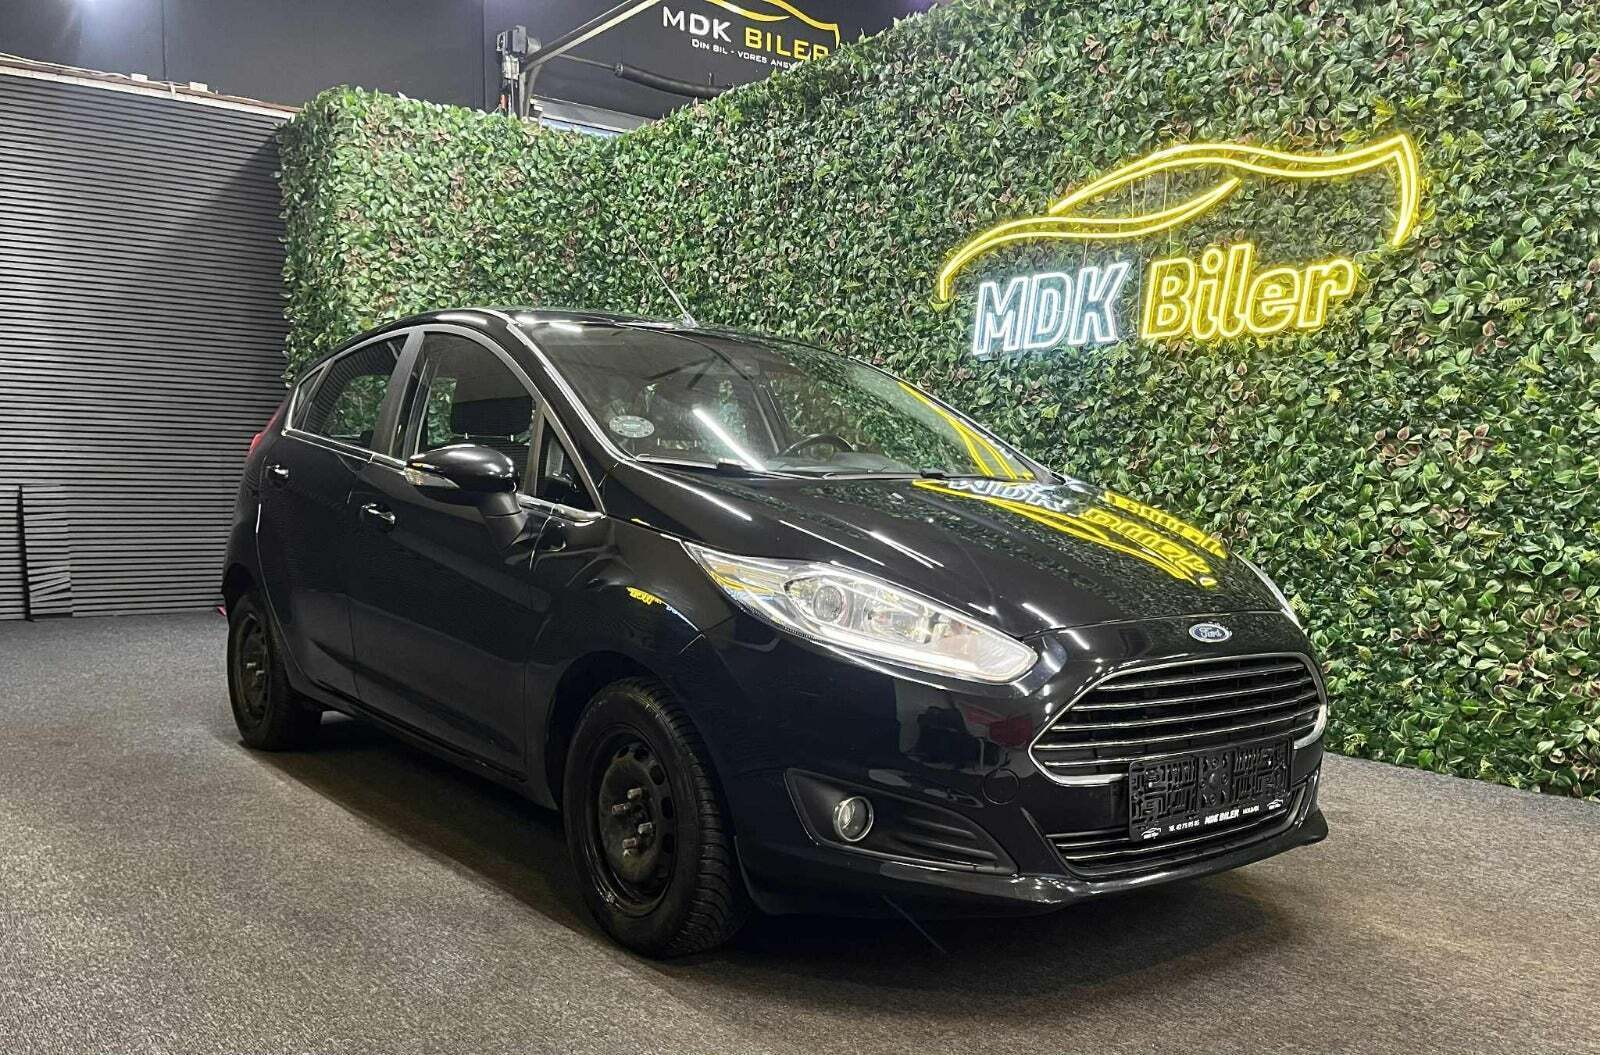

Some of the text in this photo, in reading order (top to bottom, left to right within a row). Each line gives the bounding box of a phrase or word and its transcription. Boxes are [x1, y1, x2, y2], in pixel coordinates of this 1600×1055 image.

[662, 6, 829, 61] MDK BILER
[713, 44, 728, 54] BIL
[737, 51, 768, 64] VORES
[973, 243, 1356, 355] MDK Biler
